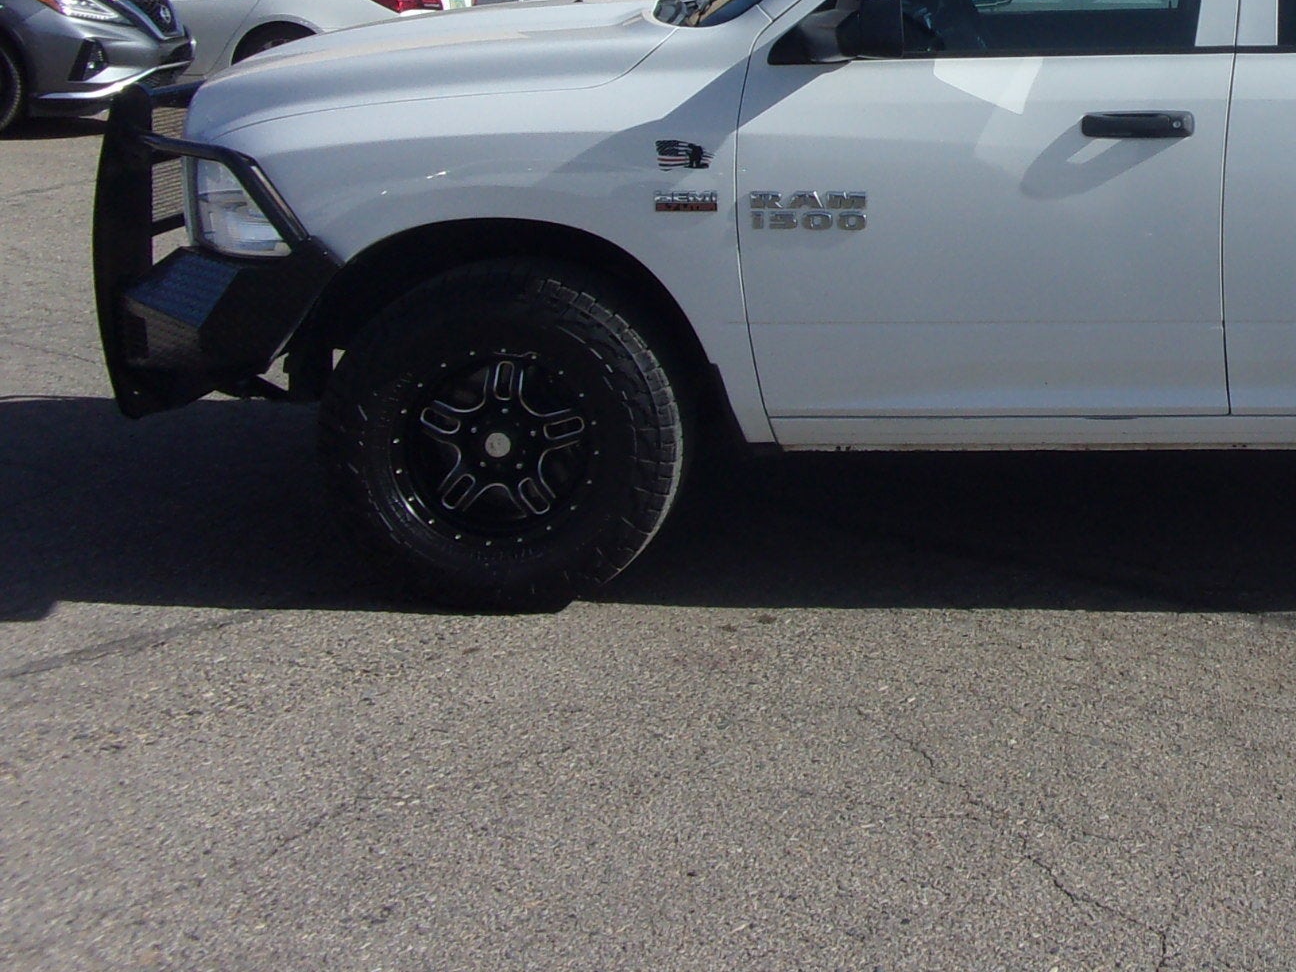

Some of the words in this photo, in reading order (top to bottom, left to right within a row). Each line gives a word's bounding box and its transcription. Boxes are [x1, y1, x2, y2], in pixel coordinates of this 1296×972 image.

[655, 190, 718, 203] HEMI
[749, 190, 866, 209] RAM
[750, 210, 867, 230] 1500
